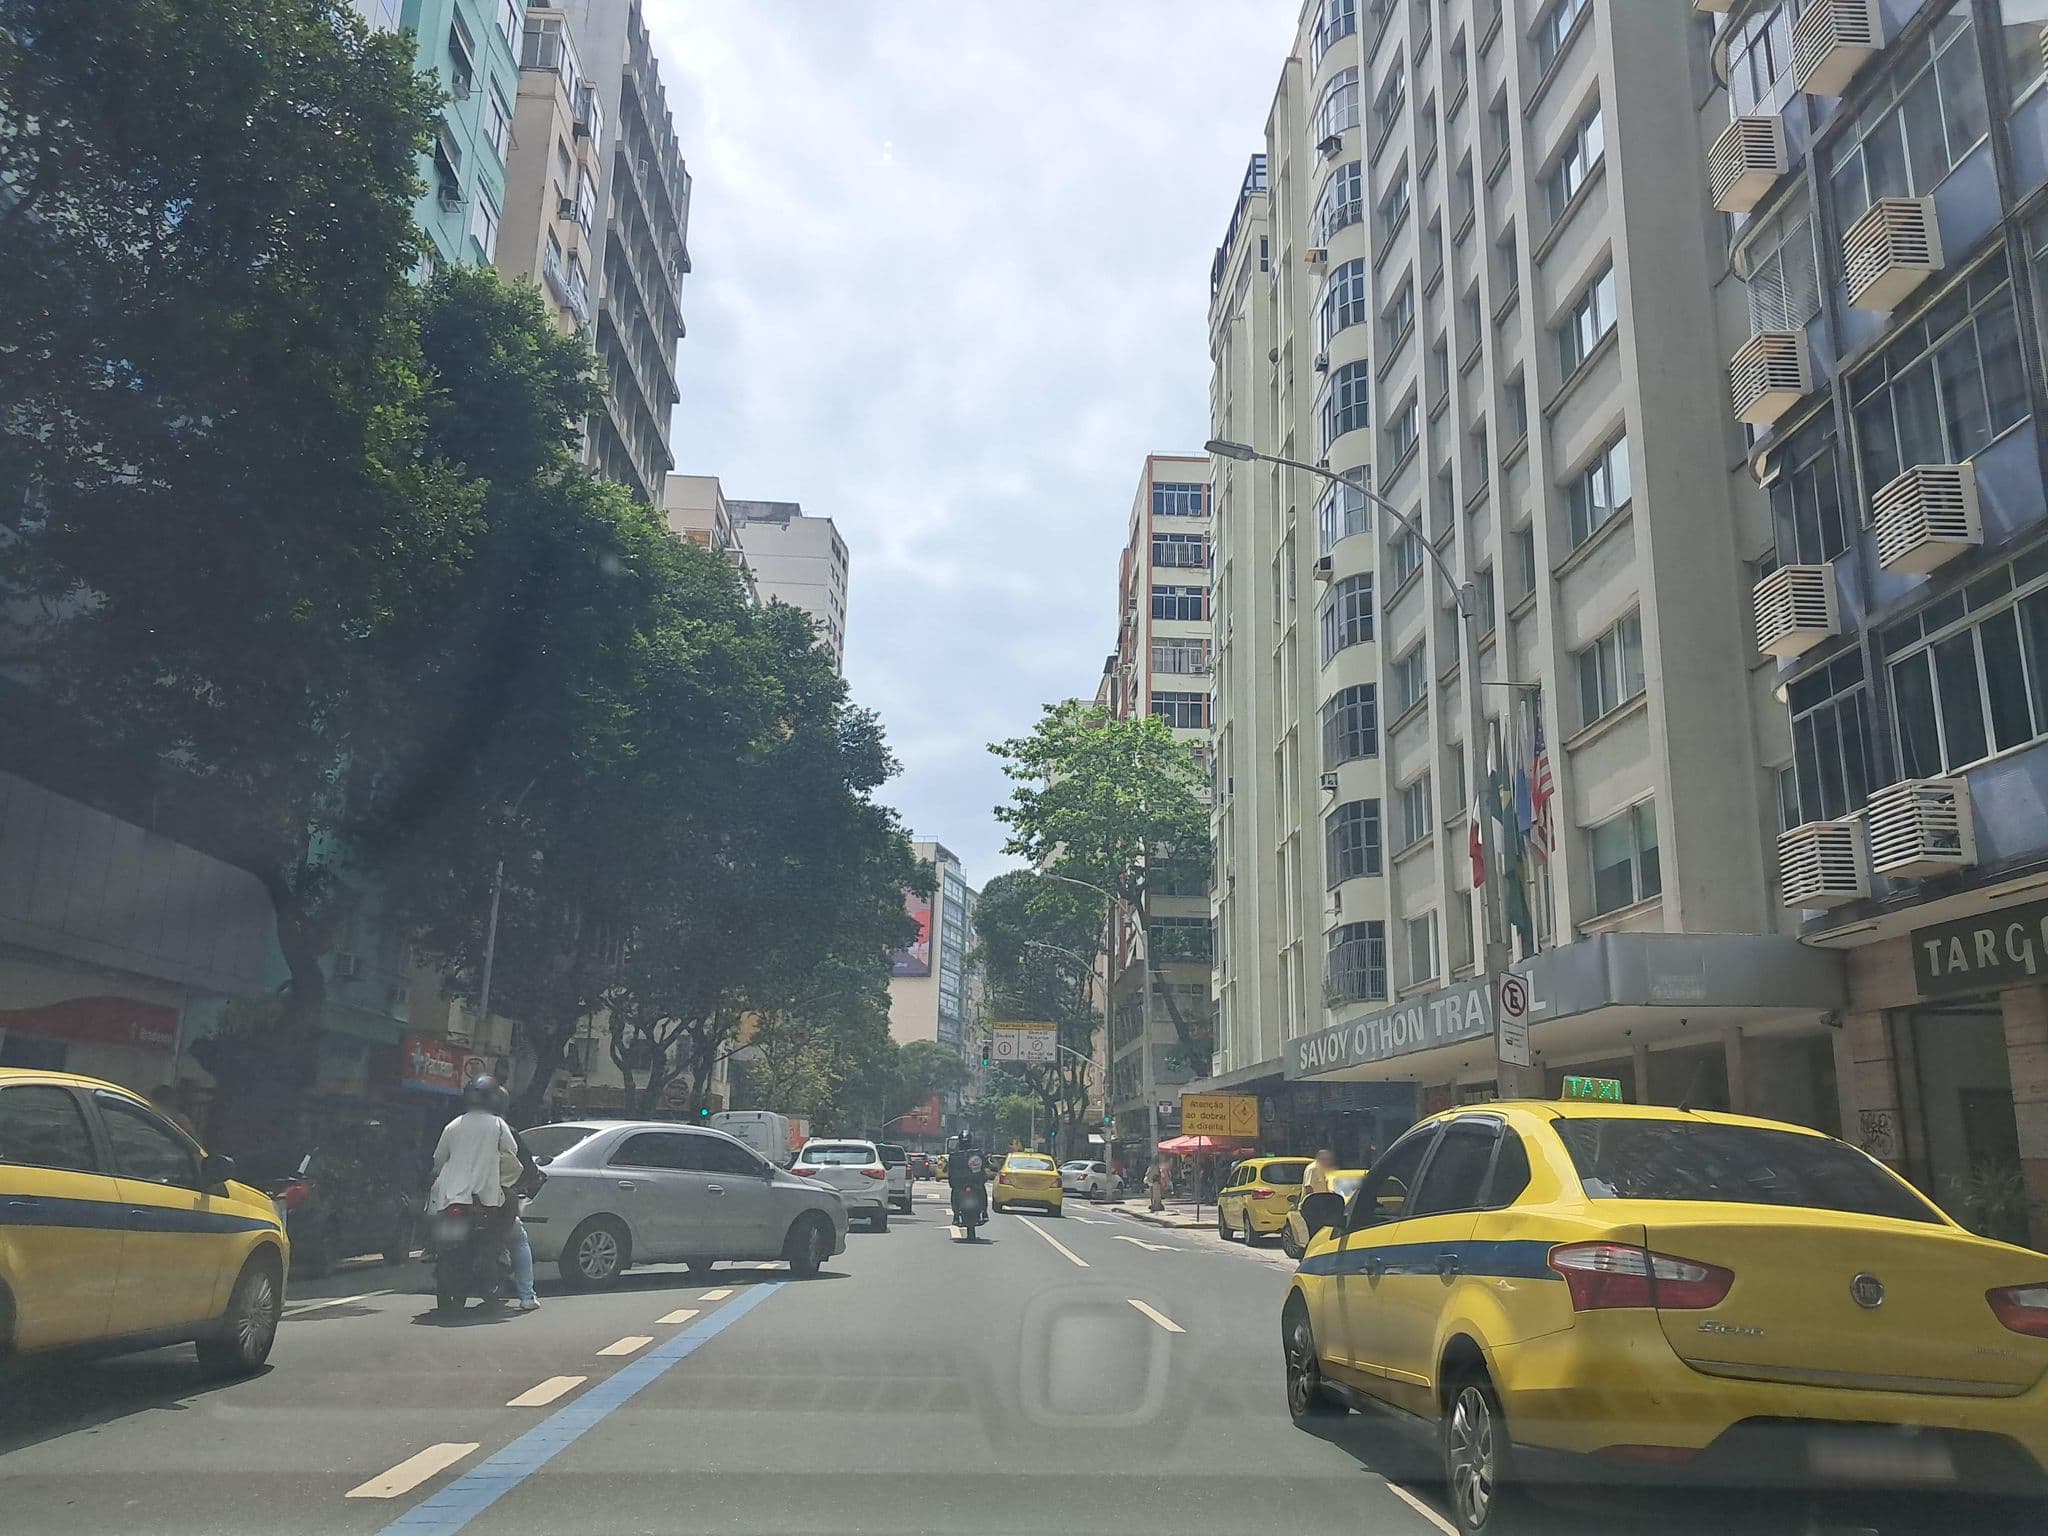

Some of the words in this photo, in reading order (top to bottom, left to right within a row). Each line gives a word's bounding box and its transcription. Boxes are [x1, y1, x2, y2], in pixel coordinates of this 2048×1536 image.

[1923, 916, 2048, 976] TARG
[1300, 1029, 1349, 1070] SAVOY
[1354, 1006, 1424, 1056] OTHON
[1431, 970, 1546, 1036] TRAL
[1567, 1076, 1619, 1100] TAXI
